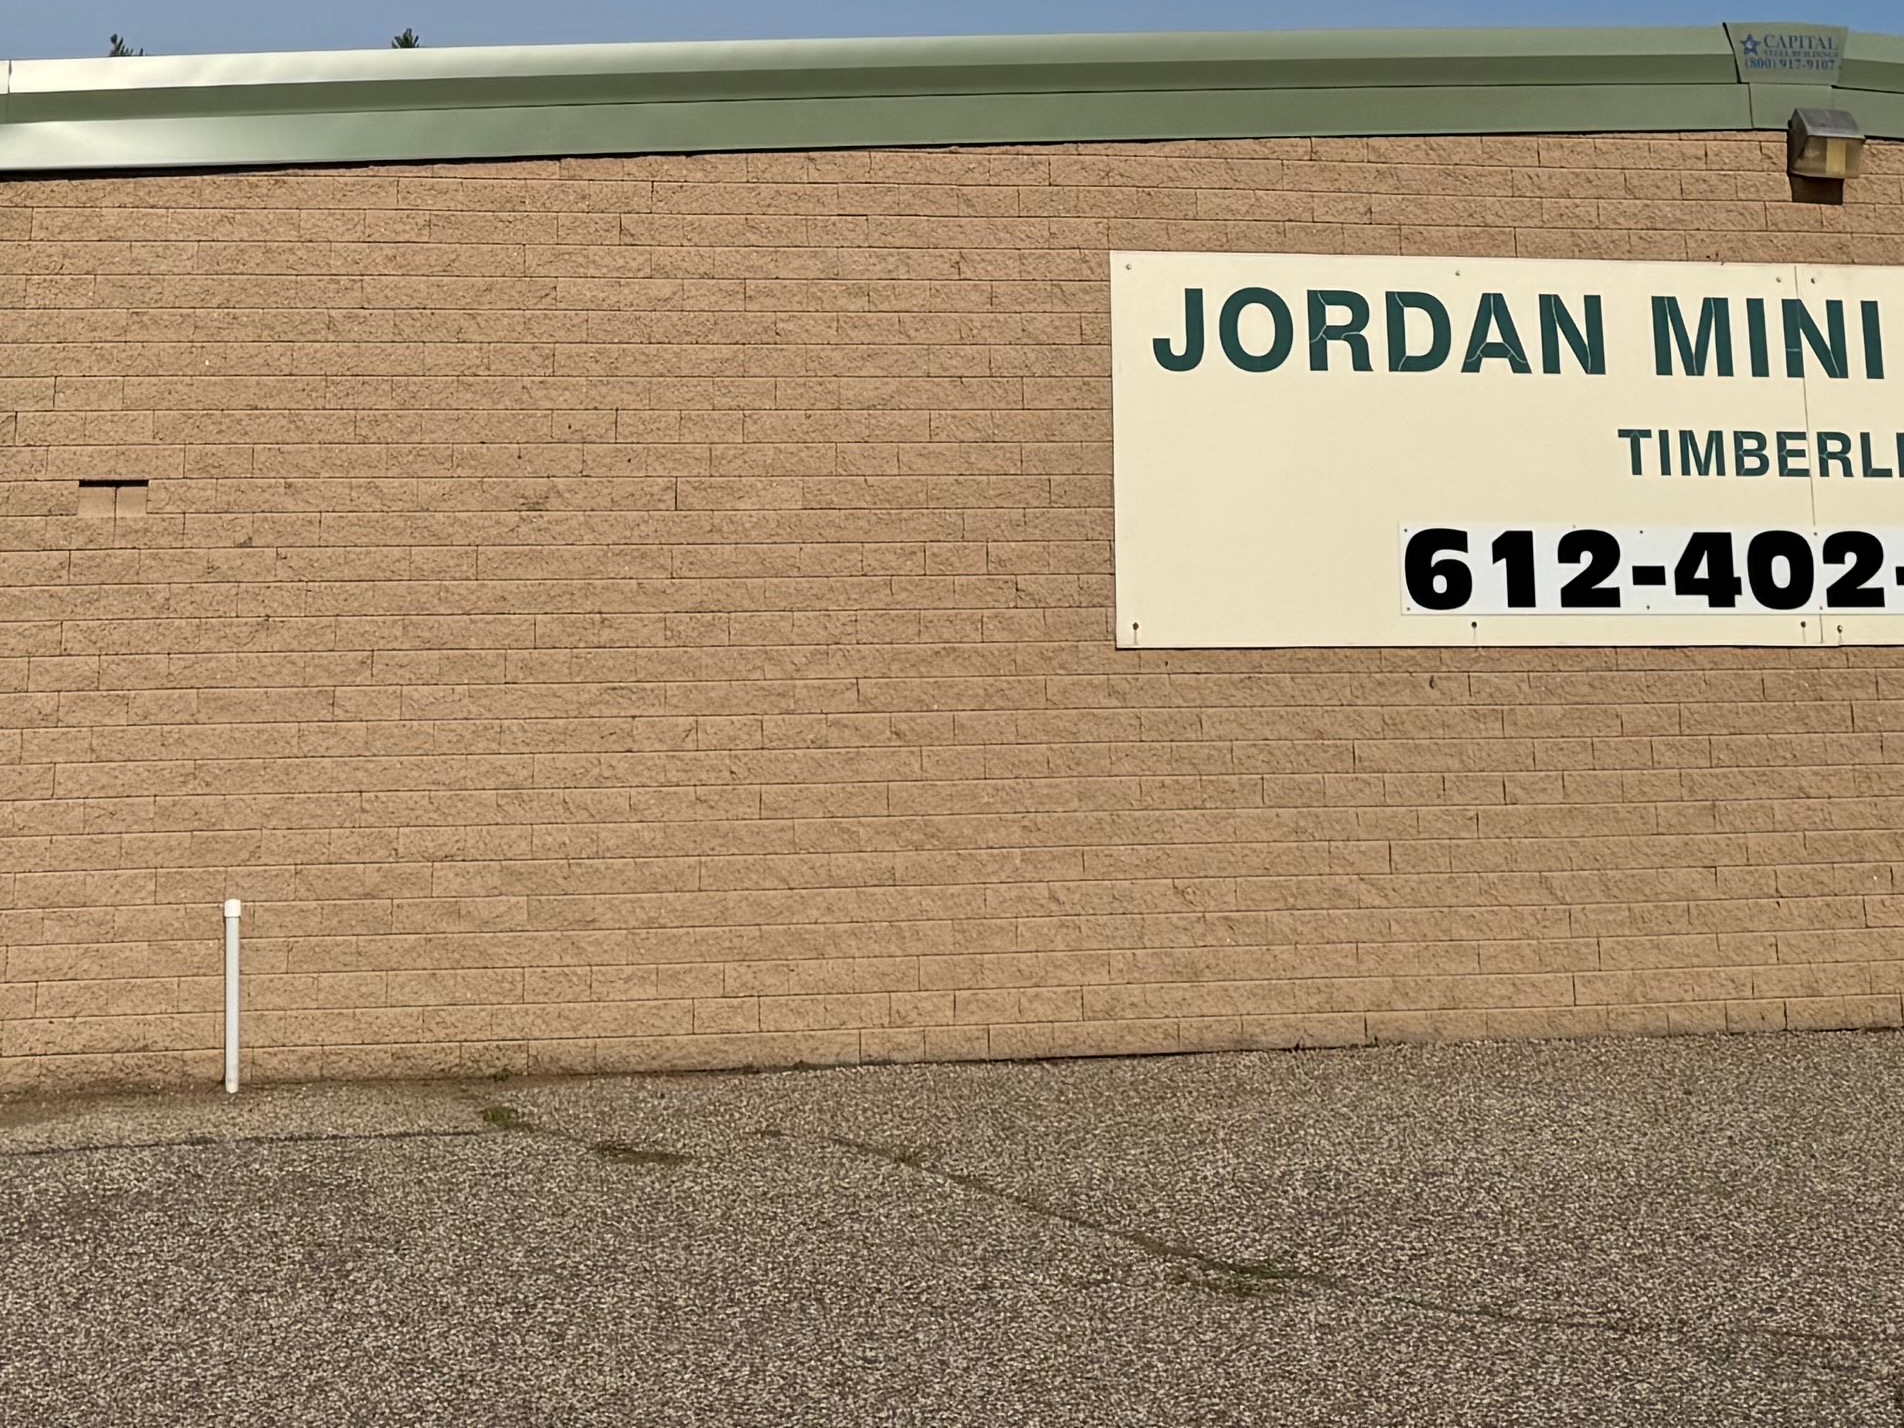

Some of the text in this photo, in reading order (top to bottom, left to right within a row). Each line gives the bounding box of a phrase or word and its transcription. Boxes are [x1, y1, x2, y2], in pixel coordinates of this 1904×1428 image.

[1763, 33, 1836, 50] CAPITAL
[1744, 57, 1835, 71] (800) 917-9107
[1152, 287, 1606, 375] JORDAN
[1651, 295, 1886, 380] MINI
